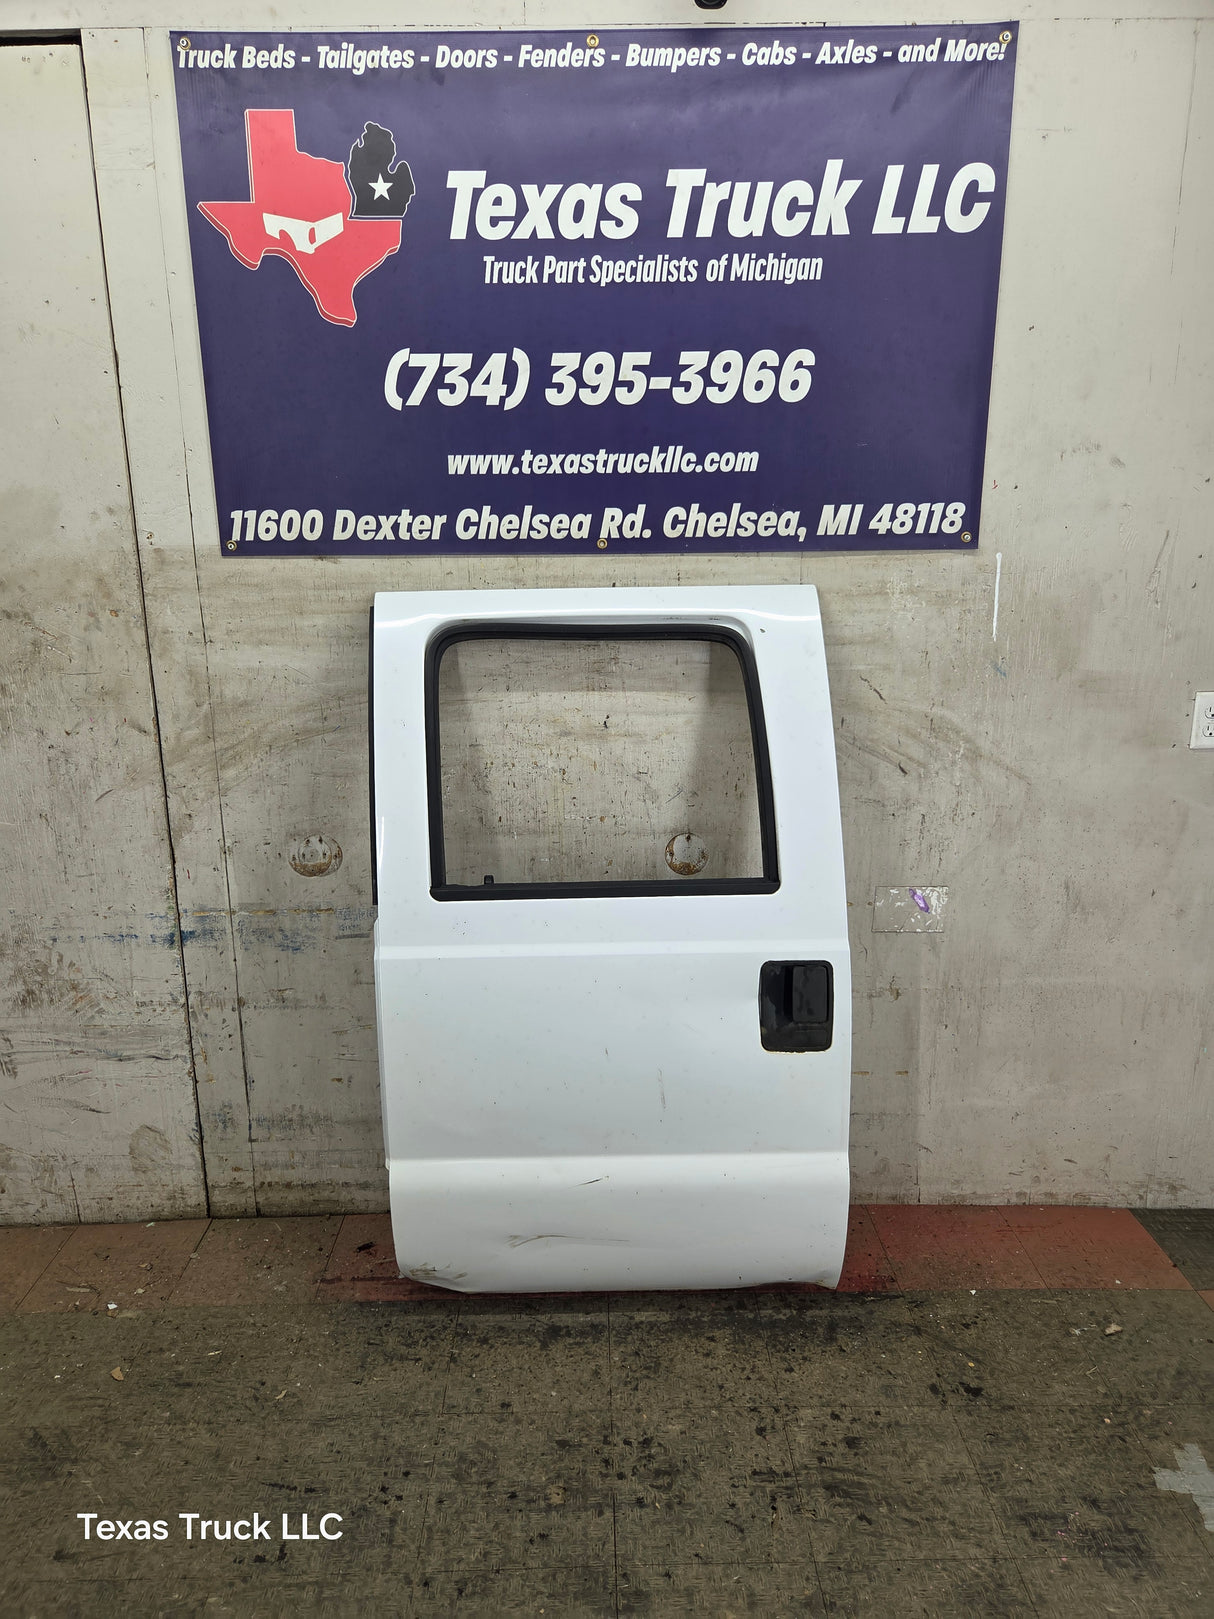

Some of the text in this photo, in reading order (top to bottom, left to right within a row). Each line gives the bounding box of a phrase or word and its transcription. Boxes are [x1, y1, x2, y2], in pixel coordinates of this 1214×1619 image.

[177, 44, 235, 68] Truck
[242, 45, 295, 68] Beds
[317, 43, 414, 75] Tailgates
[435, 43, 497, 68] Doors
[518, 42, 605, 68] Fenders
[625, 42, 721, 72] Bumpers
[741, 40, 797, 66] Cabs
[815, 38, 878, 64] Axles
[897, 37, 938, 62] and
[944, 37, 1007, 62] More!
[445, 158, 996, 241] Texas Truck LLC
[482, 252, 824, 287] Truck Part Specialists of Michigan
[384, 346, 816, 412] (734) 395-3966
[447, 445, 760, 475] www.texastruckllc.com
[230, 501, 966, 543] 11600 Dexter Chelsea Rd. Chelsea, MI 48118
